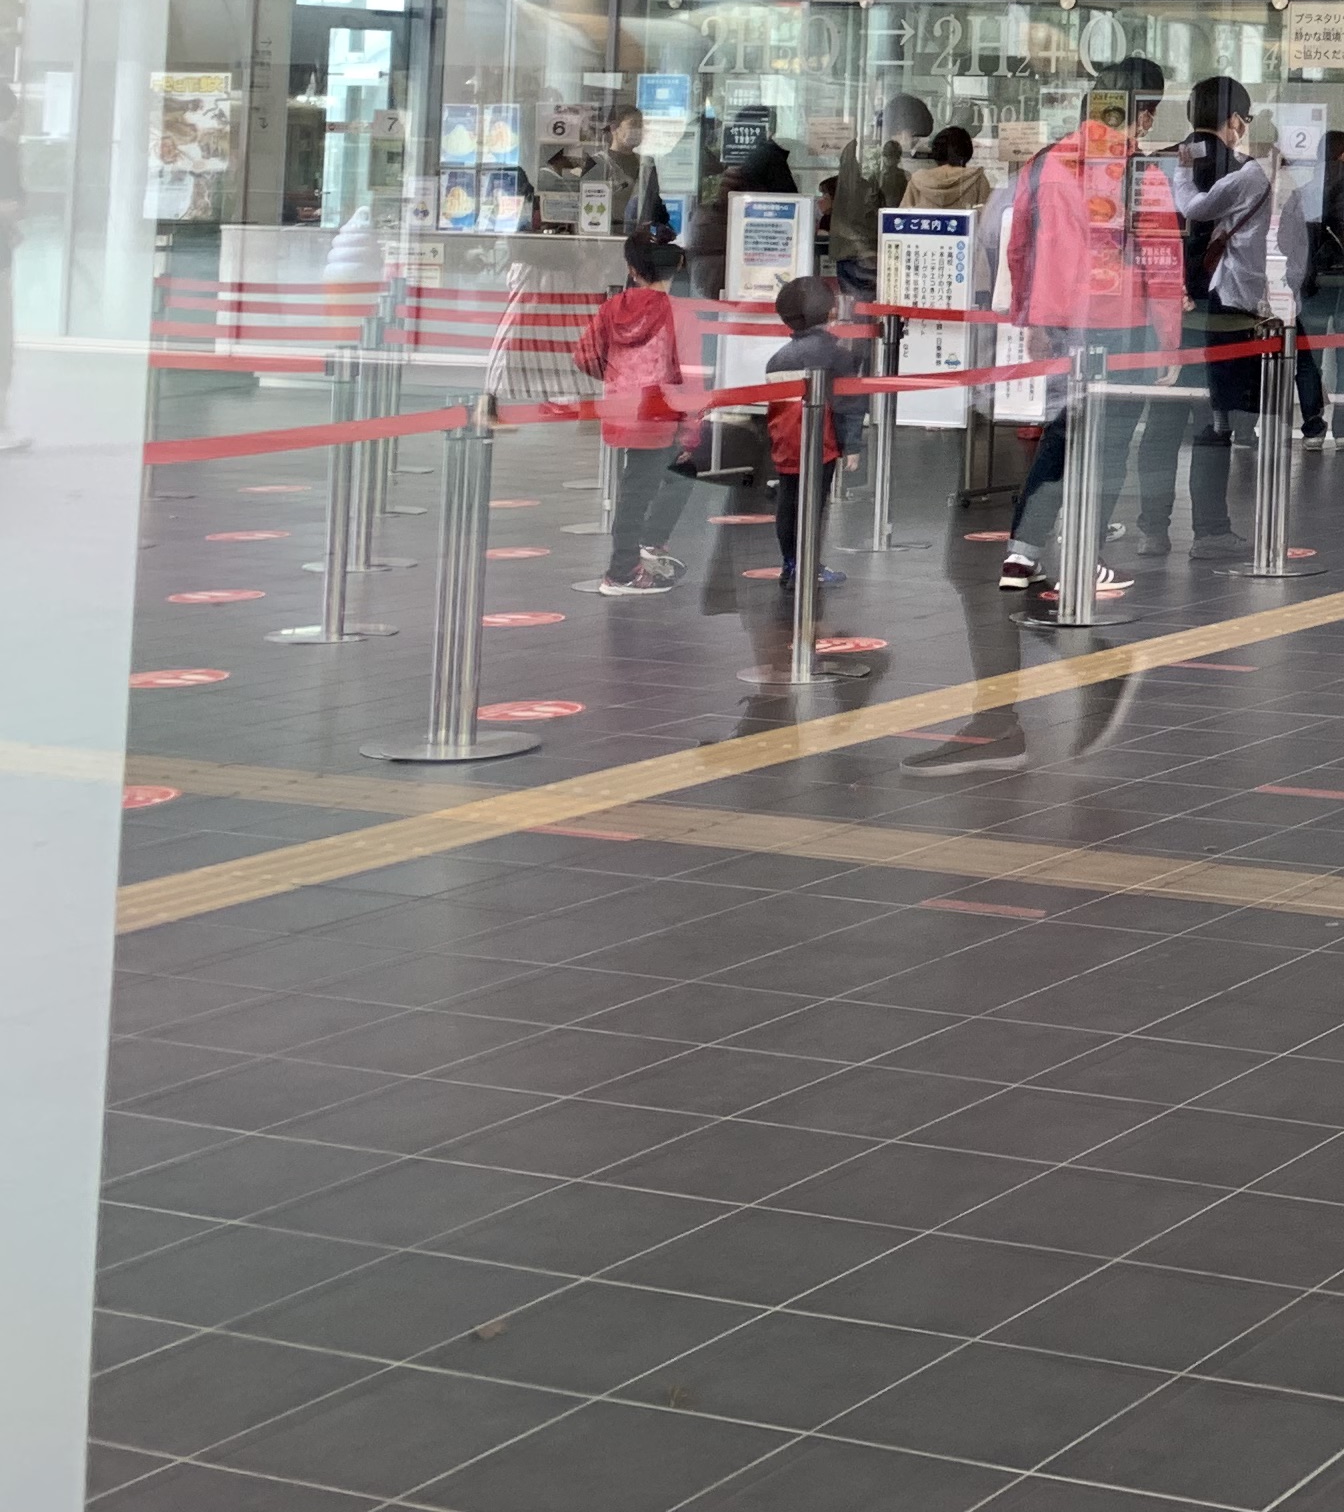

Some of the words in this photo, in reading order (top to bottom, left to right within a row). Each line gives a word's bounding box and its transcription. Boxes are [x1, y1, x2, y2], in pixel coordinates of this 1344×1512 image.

[552, 121, 566, 136] 6
[1295, 132, 1307, 150] 2
[910, 218, 942, 231] ご案内
